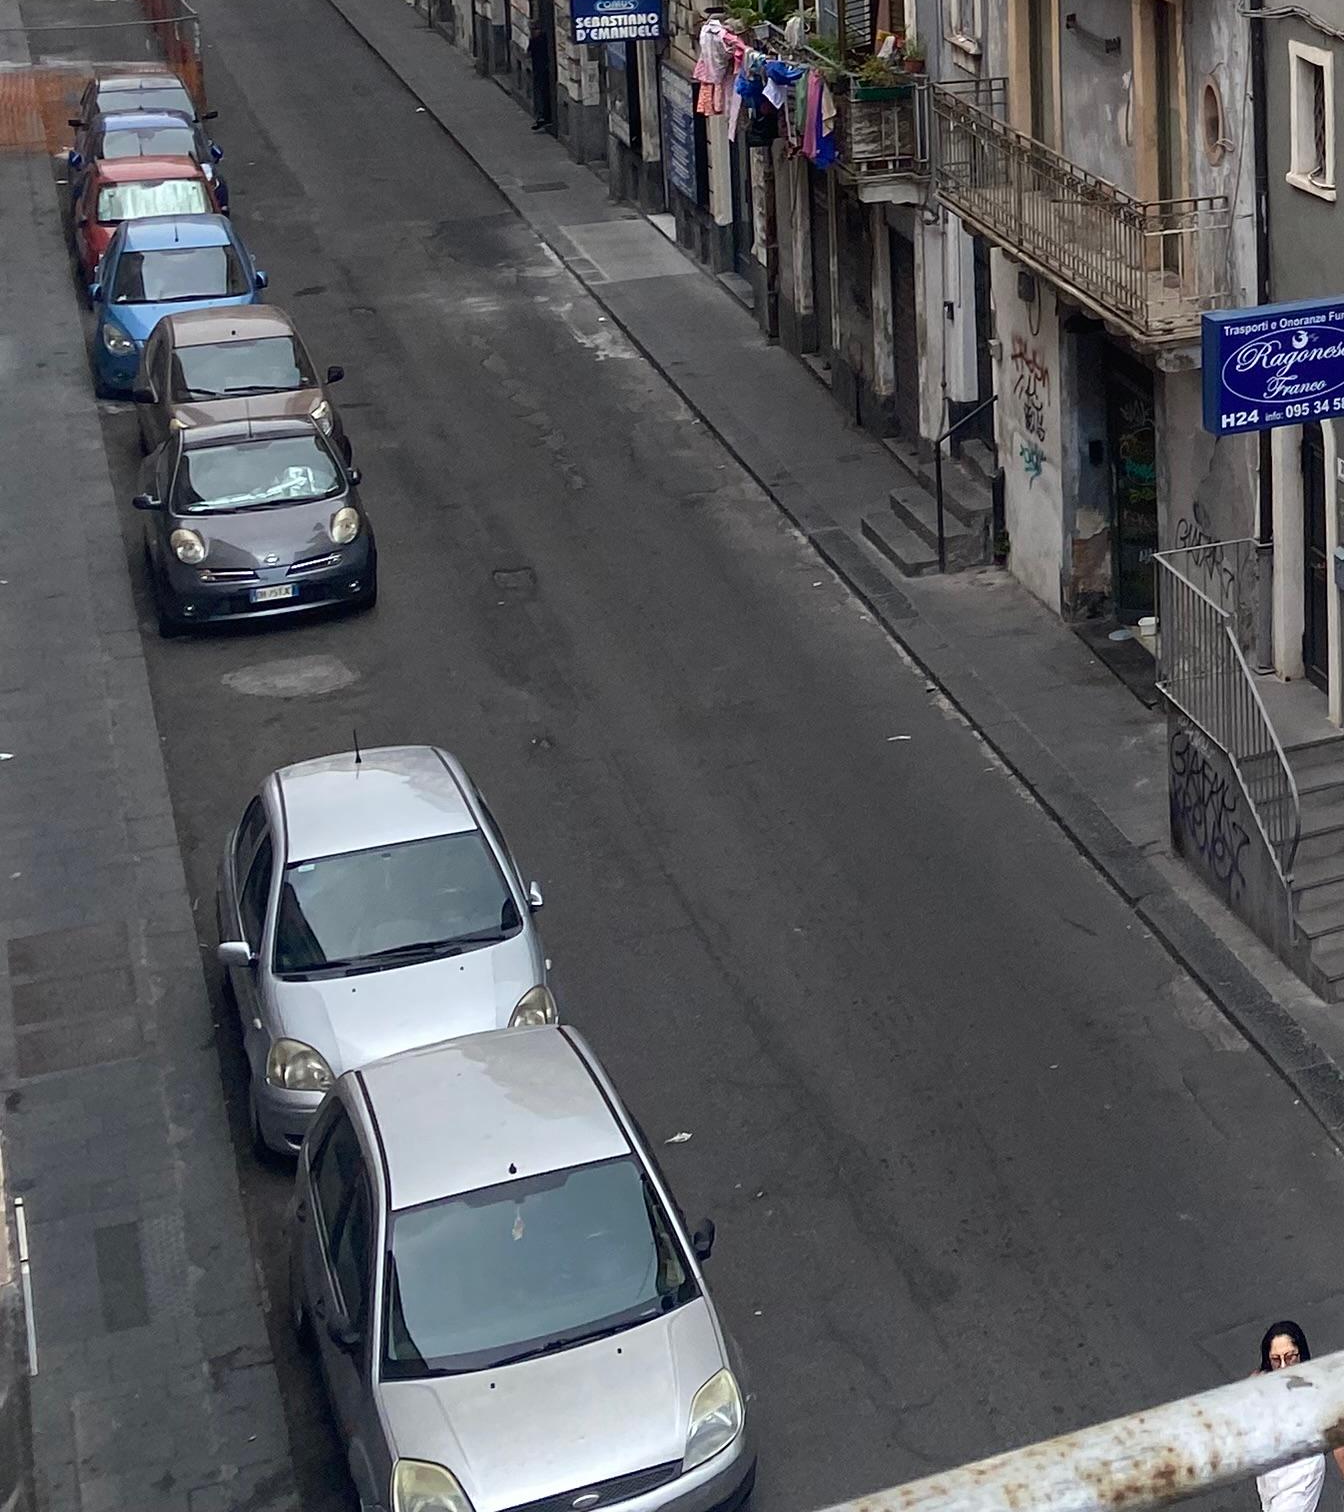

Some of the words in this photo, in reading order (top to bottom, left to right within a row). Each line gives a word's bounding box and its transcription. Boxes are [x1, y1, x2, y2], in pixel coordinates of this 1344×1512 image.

[575, 13, 658, 29] SEBASTIANO
[575, 24, 659, 41] D'EMANUELE
[1224, 321, 1269, 336] Trasporti
[1270, 322, 1277, 330] e
[1279, 314, 1326, 329] Onoranze
[1263, 375, 1327, 399] Franco
[1221, 409, 1259, 429] H24
[1265, 411, 1284, 422] info:
[1285, 403, 1310, 419] 095
[1313, 399, 1330, 414] 34
